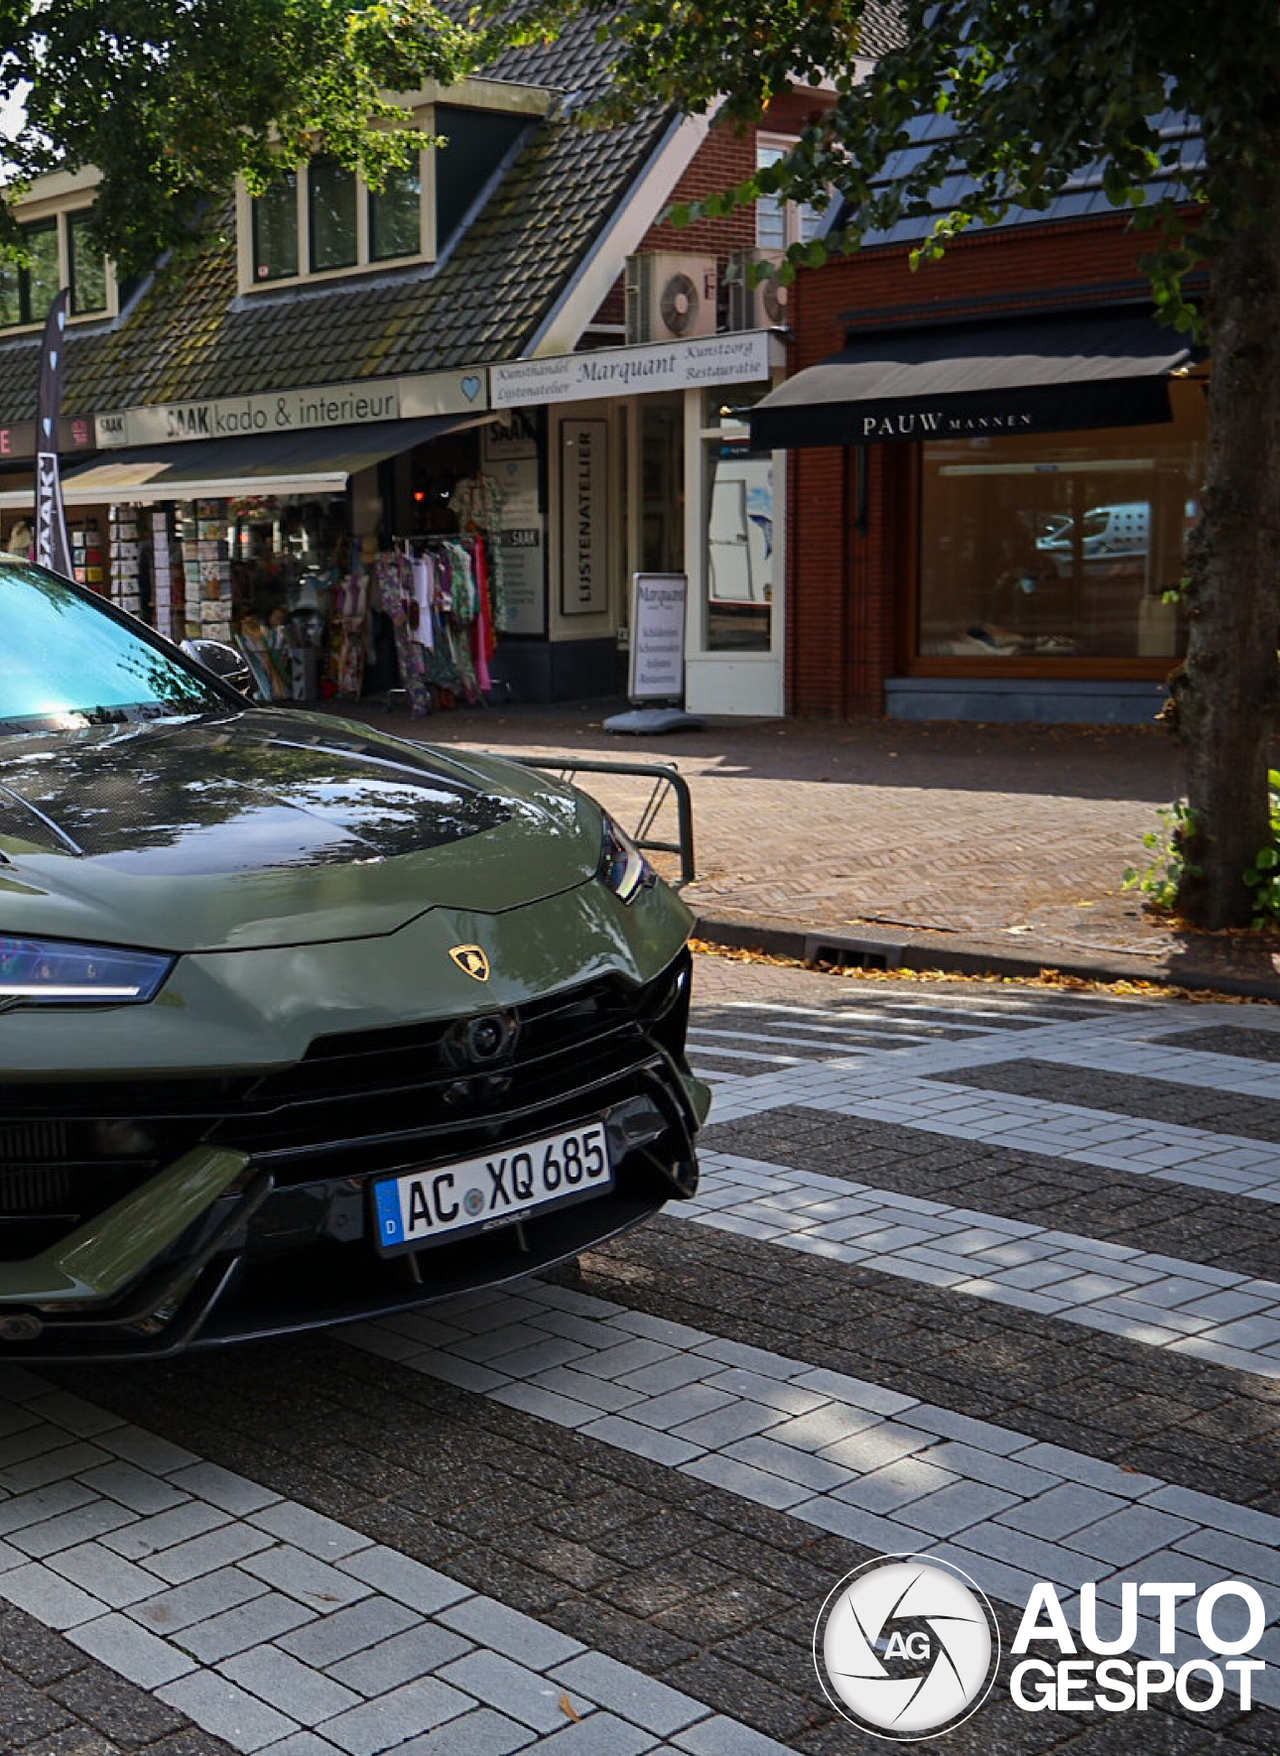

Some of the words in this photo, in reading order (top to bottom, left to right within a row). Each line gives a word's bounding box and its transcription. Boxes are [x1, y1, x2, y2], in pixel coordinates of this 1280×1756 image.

[683, 340, 754, 361] Kunstzorg
[576, 354, 678, 383] Marquant
[685, 360, 761, 382] Restauratie
[166, 405, 211, 437] SAAK
[215, 401, 267, 434] kado
[275, 397, 292, 426] &
[299, 392, 395, 425] interieur
[863, 413, 943, 436] PAUW
[949, 414, 1032, 430] MANNEN
[578, 432, 591, 603] LIJSTENATELIER
[510, 530, 537, 547] SAAK
[408, 1173, 460, 1232] AC
[486, 1152, 535, 1210] XQ
[543, 1129, 604, 1192] 685
